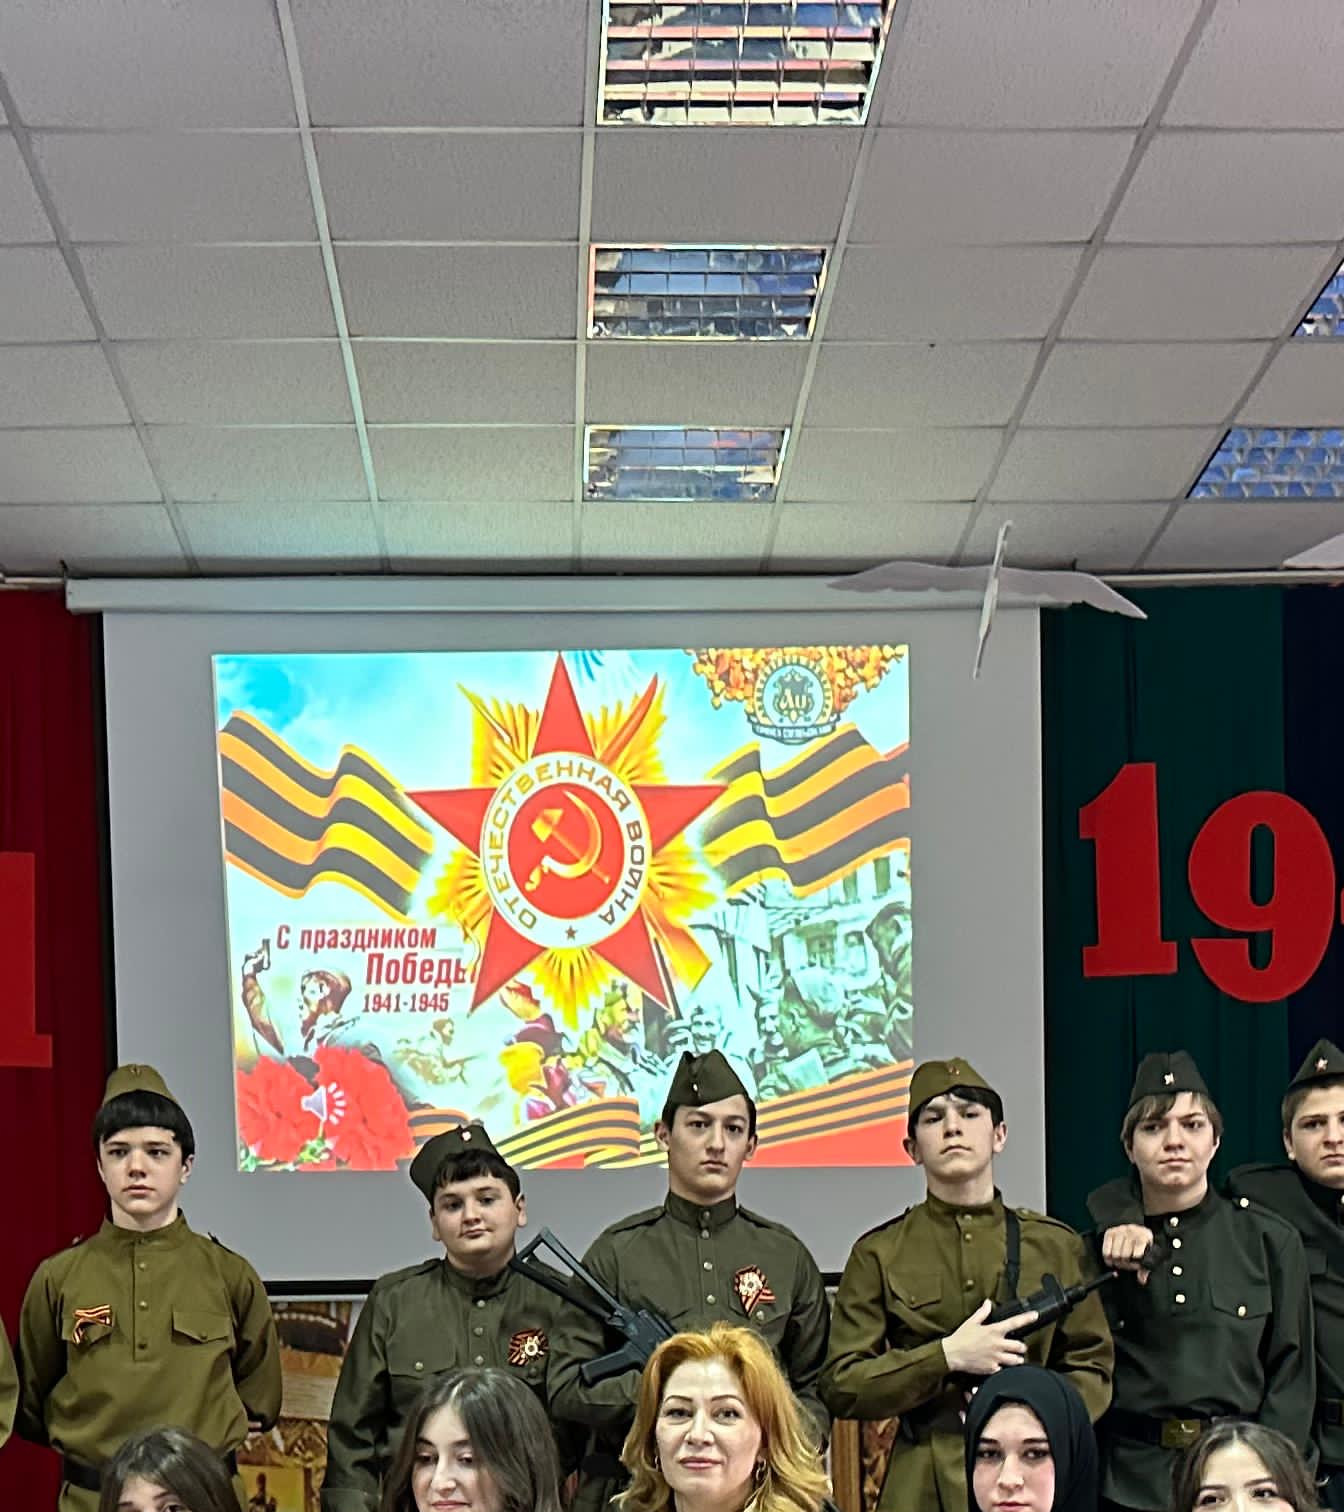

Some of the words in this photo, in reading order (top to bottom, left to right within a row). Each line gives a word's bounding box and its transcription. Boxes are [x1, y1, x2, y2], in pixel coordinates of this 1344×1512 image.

[488, 760, 631, 930] ОТЕЧЕСТВЕННАЯ
[276, 924, 291, 950] С
[299, 927, 437, 953] праздником
[362, 992, 450, 1013] 1941-1945
